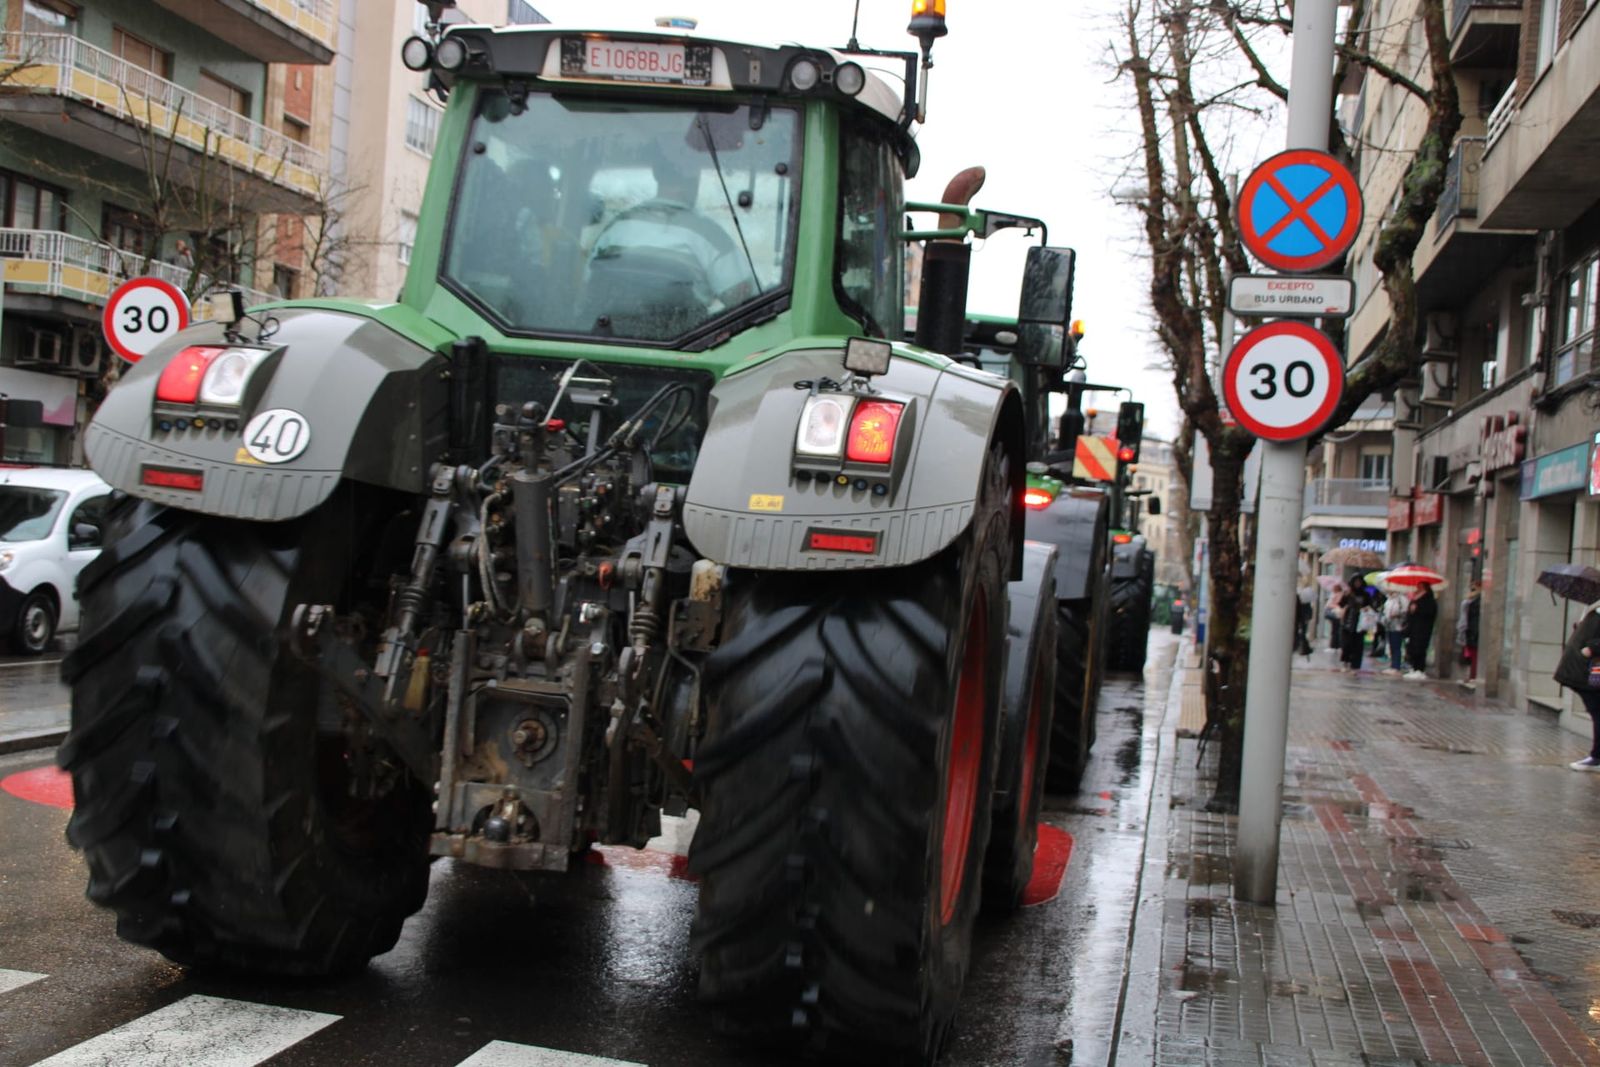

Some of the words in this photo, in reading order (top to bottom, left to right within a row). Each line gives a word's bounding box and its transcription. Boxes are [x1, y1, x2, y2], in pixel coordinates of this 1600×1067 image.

[591, 47, 682, 73] E1068BJG
[1267, 281, 1315, 291] EXCEPTO
[1254, 295, 1276, 304] BUS
[1279, 295, 1324, 305] URBANO
[122, 305, 169, 334] 30
[1249, 360, 1315, 401] 30
[250, 414, 302, 457] 40
